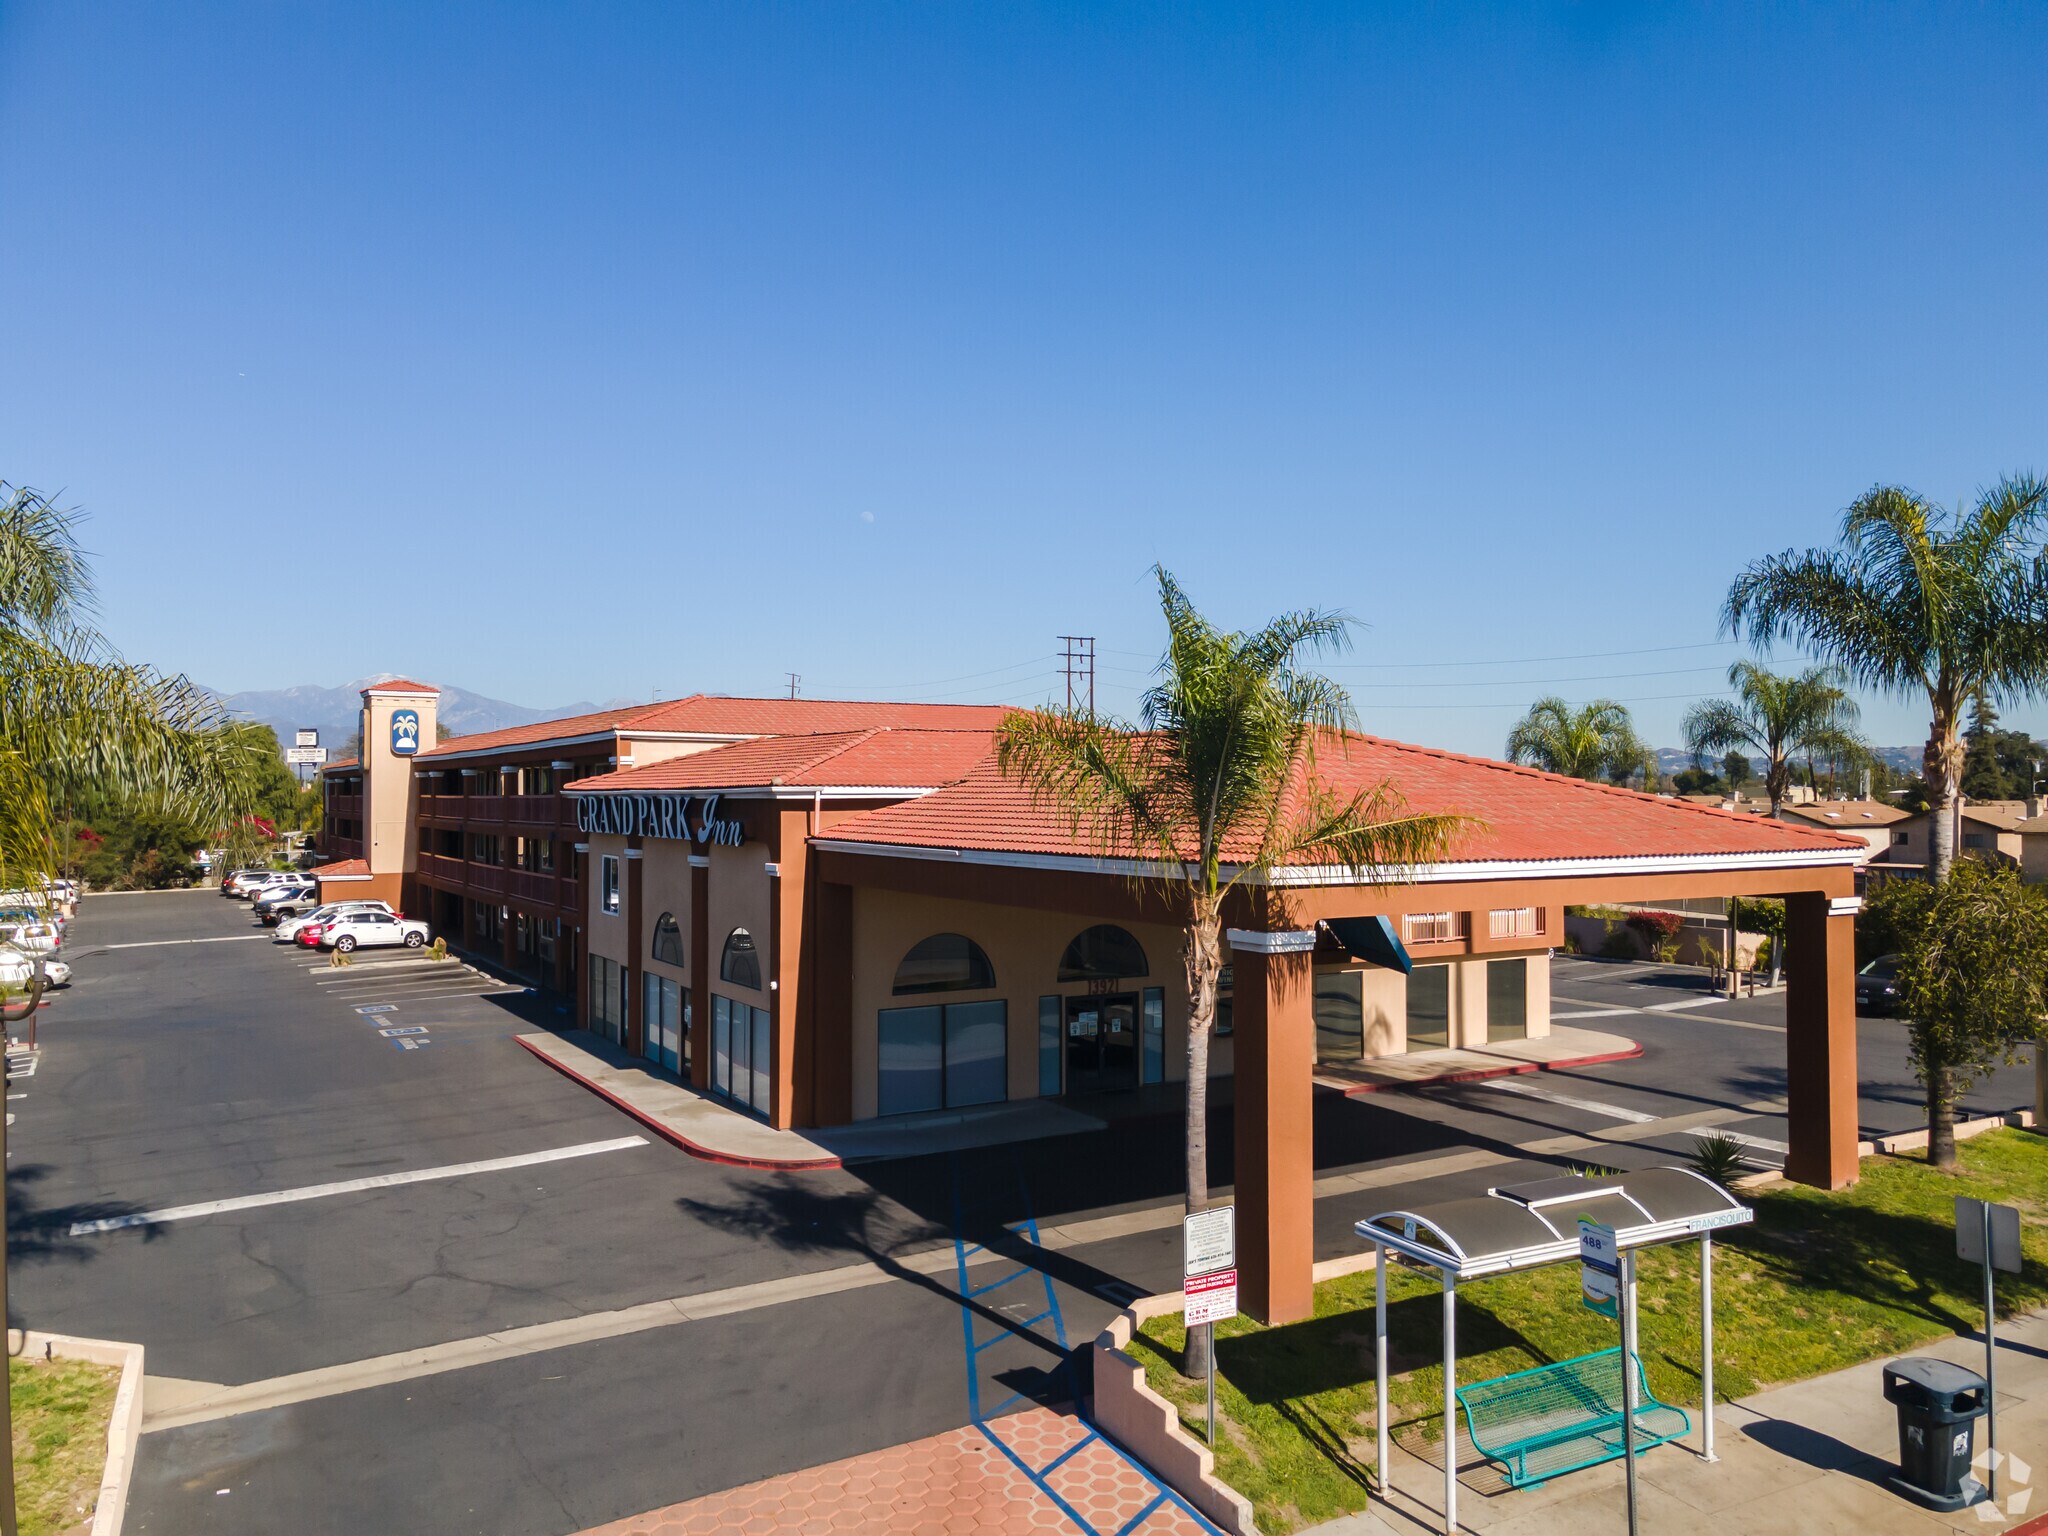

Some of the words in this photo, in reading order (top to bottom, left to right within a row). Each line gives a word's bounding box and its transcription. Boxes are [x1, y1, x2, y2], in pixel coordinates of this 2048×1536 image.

[577, 796, 633, 835] GRAND
[634, 796, 691, 840] PARK
[697, 795, 742, 847] Inn
[1088, 977, 1119, 995] 13921
[1690, 1210, 1752, 1231] FRANCISQUITO
[1582, 1235, 1602, 1250] 488
[1186, 1278, 1207, 1286] PRIVATE
[1207, 1273, 1234, 1282] PROPERTY
[1188, 1313, 1210, 1322] TOWING
